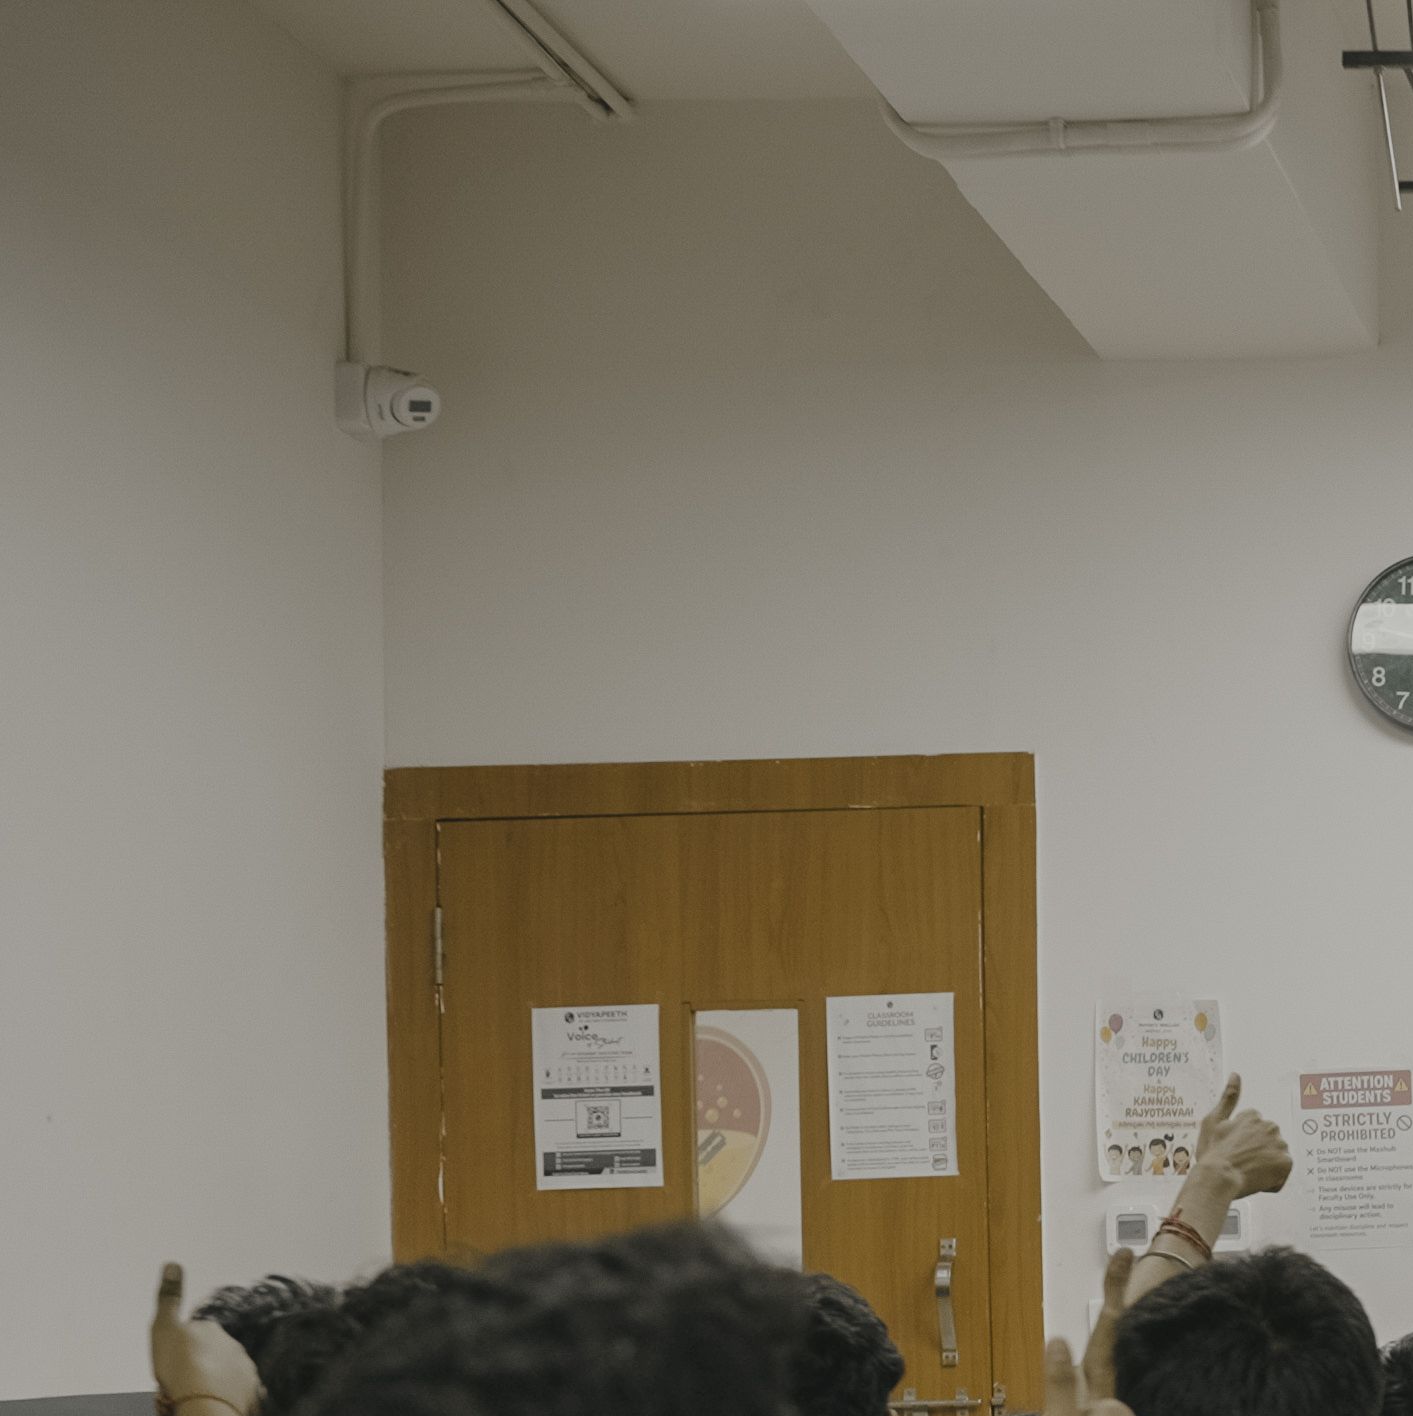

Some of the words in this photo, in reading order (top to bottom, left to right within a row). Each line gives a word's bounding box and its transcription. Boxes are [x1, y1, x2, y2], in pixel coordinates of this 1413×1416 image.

[1371, 666, 1386, 687] 8
[1396, 691, 1410, 710] 7
[1142, 1035, 1177, 1051] Happy
[1122, 1051, 1190, 1064] CHILDREN'S
[1147, 1066, 1171, 1077] DAY
[1143, 1084, 1176, 1097] Happy
[1319, 1074, 1394, 1091] ATTENTION
[1133, 1096, 1184, 1106] KANNADA
[1322, 1089, 1392, 1106] STUDENTS
[1322, 1111, 1392, 1128] STRICTLY
[1320, 1127, 1396, 1142] PROHIBITED
